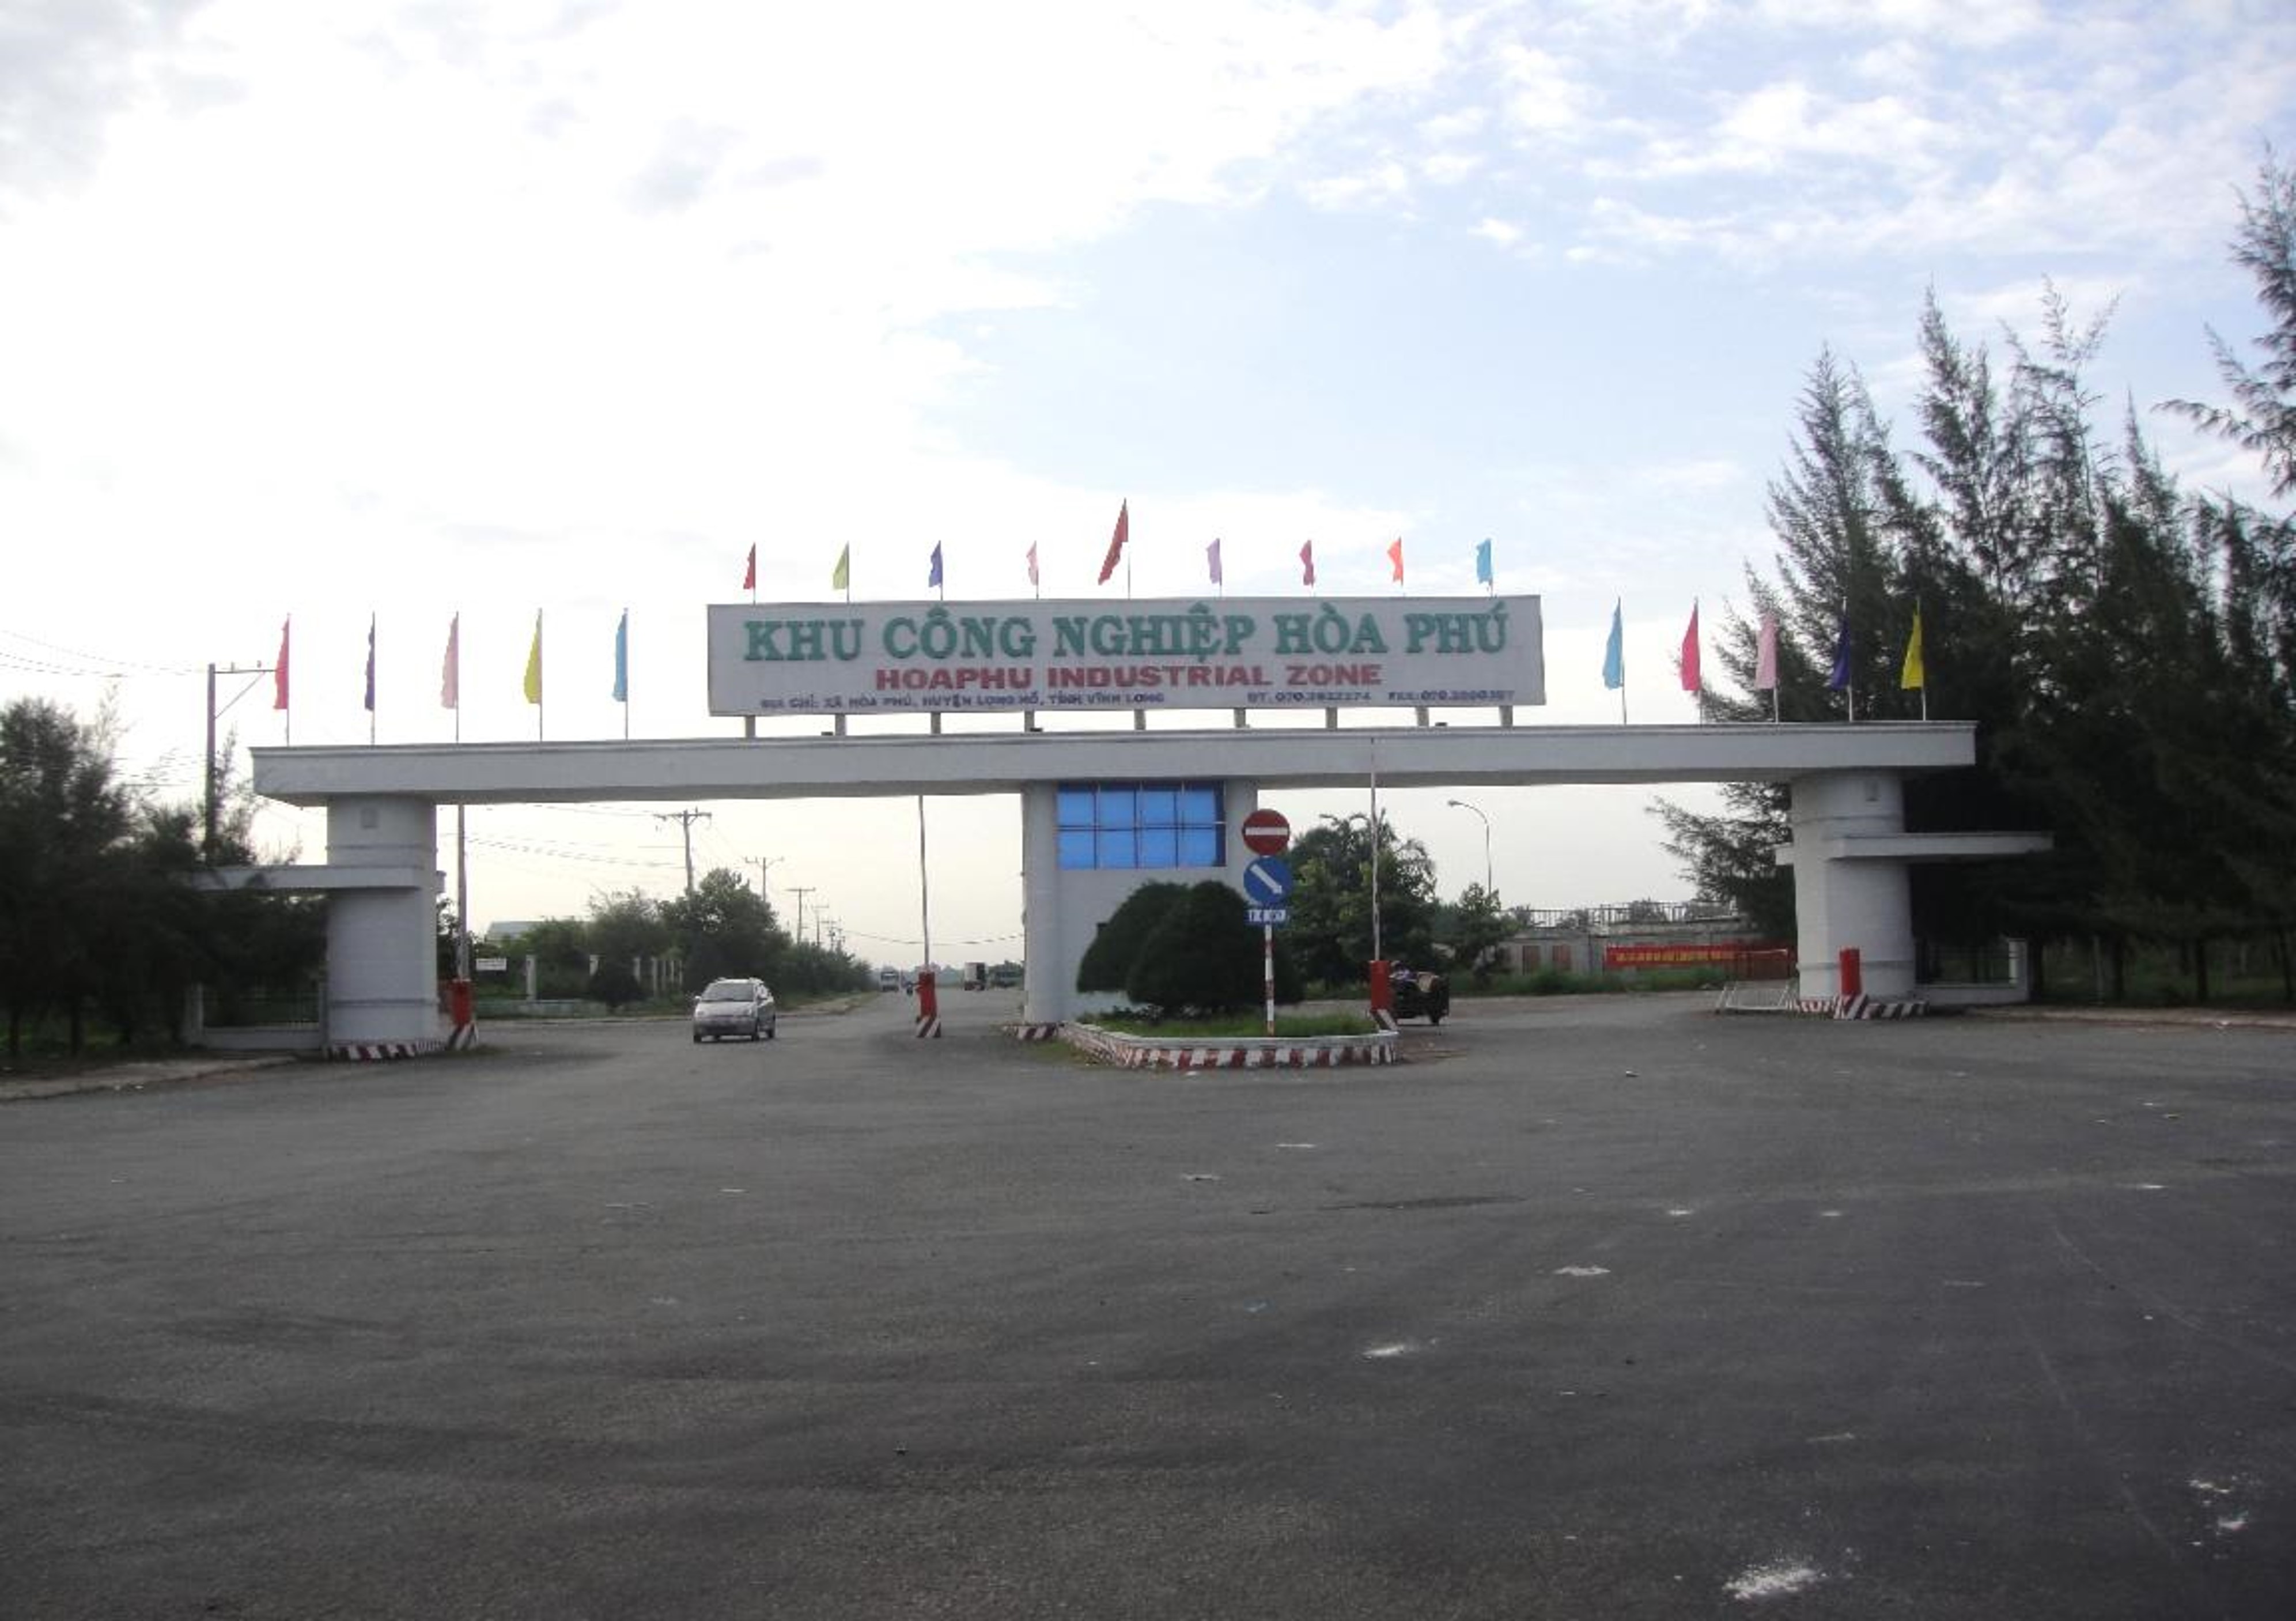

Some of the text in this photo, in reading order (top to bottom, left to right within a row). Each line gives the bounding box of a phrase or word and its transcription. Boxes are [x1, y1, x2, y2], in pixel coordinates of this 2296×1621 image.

[744, 601, 1510, 663] KHU CÔNG NGHIỆP HÒA PHÚ
[875, 663, 1382, 692] HOAPHU INDUSTRIAL ZONE
